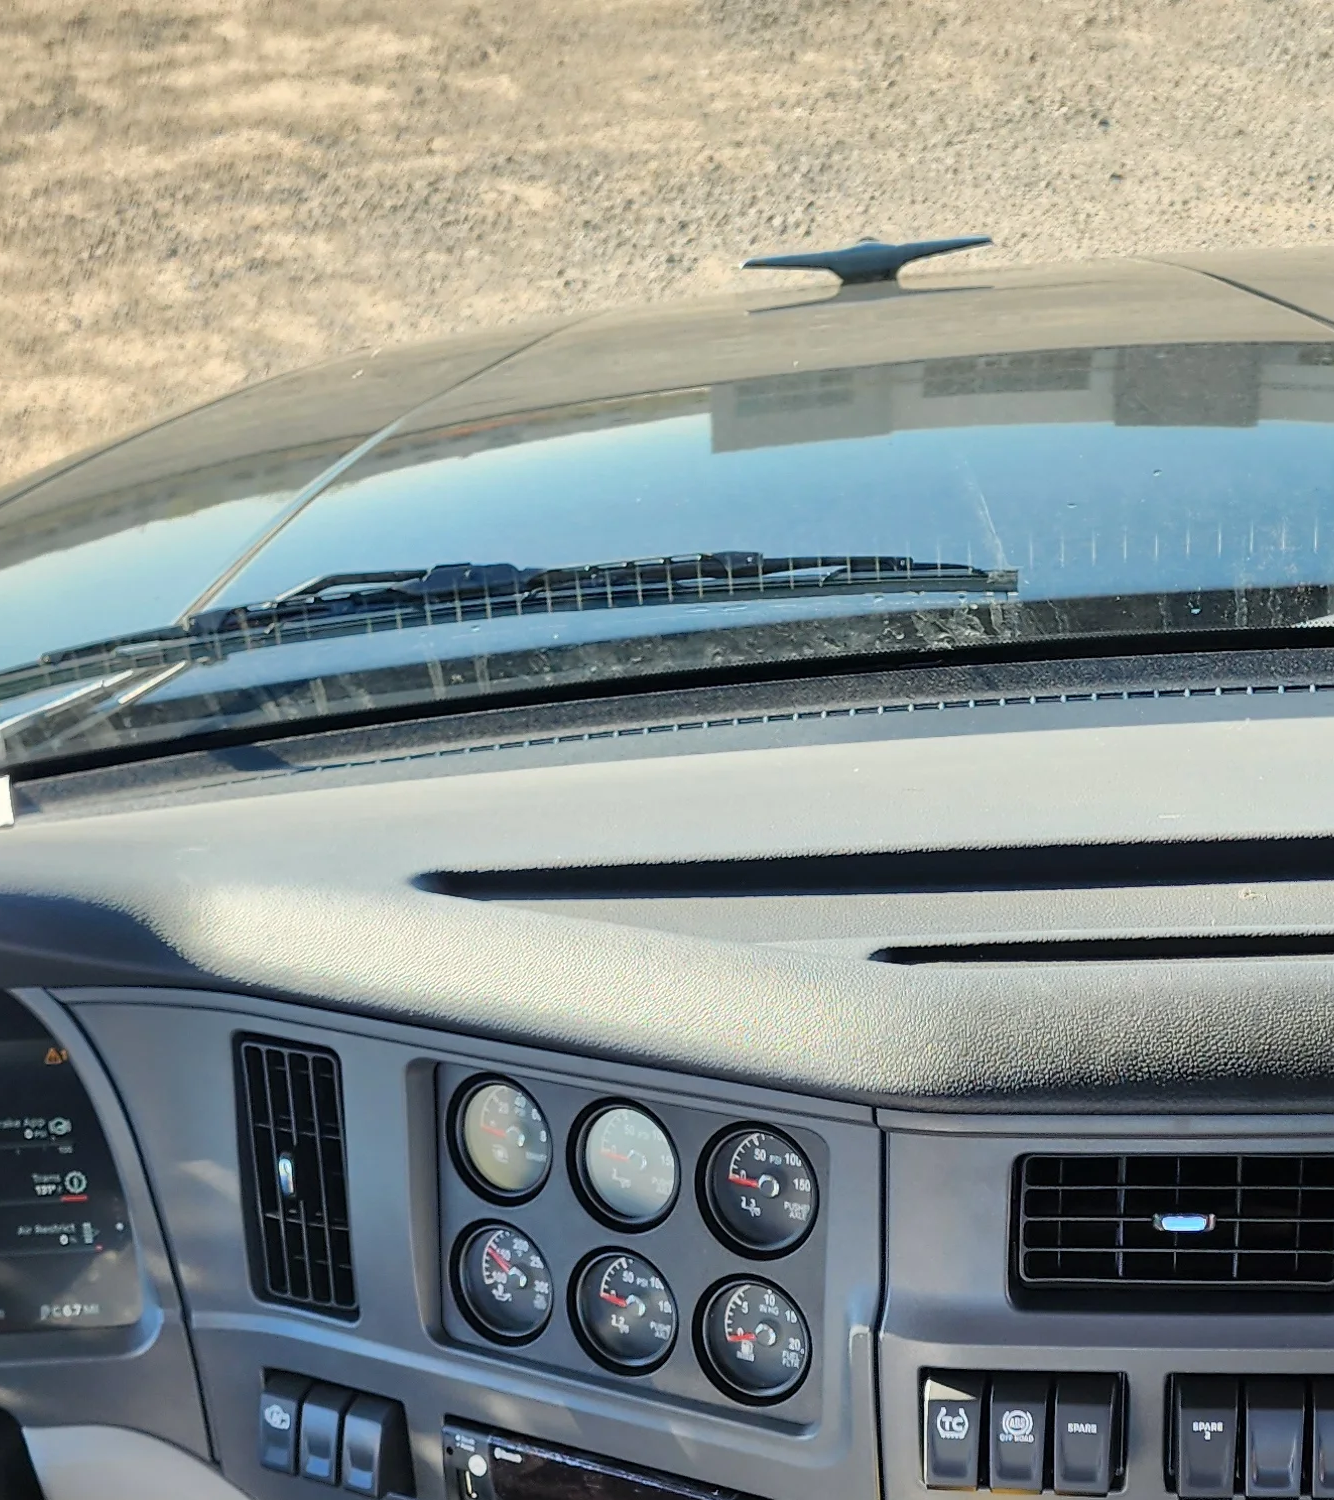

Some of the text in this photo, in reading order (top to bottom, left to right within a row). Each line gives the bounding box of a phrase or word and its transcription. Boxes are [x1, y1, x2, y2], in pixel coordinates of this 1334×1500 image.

[23, 1117, 46, 1129] App
[754, 1148, 767, 1162] 50
[769, 1154, 782, 1166] PSI
[32, 1173, 61, 1184] Trans
[792, 1177, 811, 1193] 150
[18, 1225, 32, 1236] Air
[623, 1270, 635, 1284] 50
[764, 1293, 776, 1307] 10
[742, 1300, 749, 1315] 5
[785, 1309, 798, 1324] 15
[788, 1337, 801, 1351] 20
[941, 1415, 964, 1432] TC
[1068, 1422, 1097, 1434] SPARE
[1192, 1421, 1224, 1432] SPARE
[1014, 1433, 1034, 1444] ROAD
